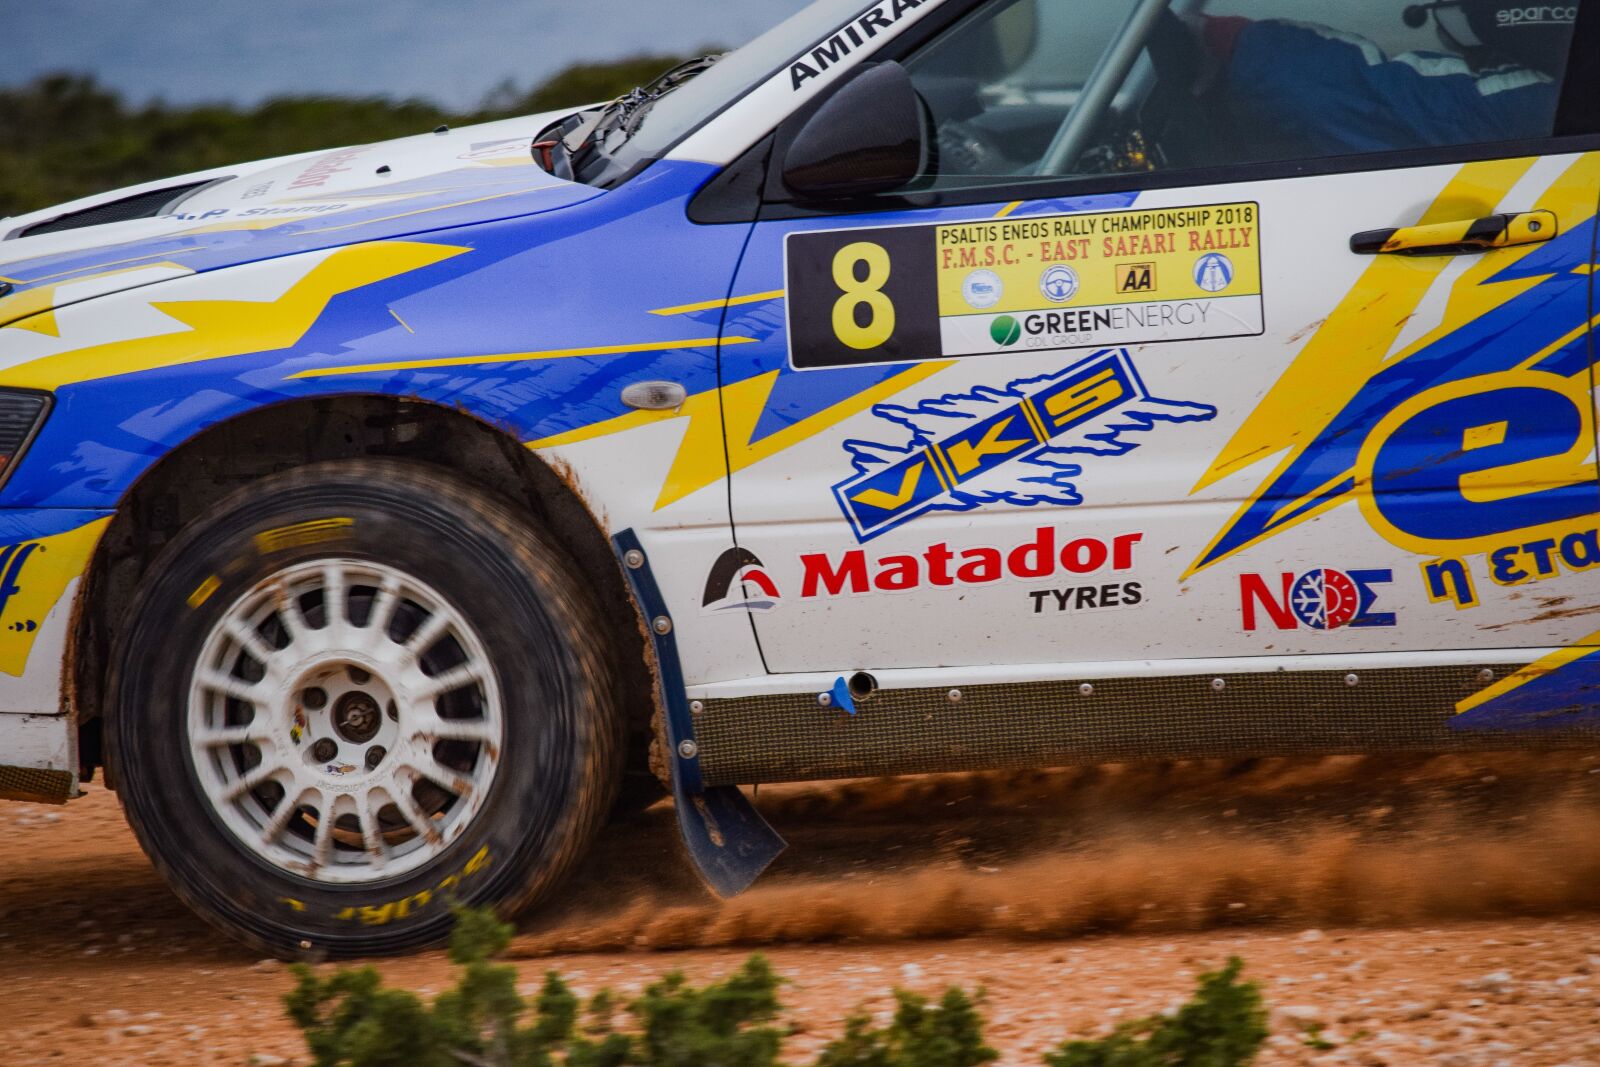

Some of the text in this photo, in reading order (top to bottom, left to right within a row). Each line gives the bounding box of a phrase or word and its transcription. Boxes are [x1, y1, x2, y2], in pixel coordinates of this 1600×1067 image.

[790, 0, 922, 91] AMIRA
[941, 207, 1253, 245] PSALTIS ENEOS RALLY CHAMPIONSHIP 2018
[942, 244, 1020, 269] F.M.S.C.
[1040, 238, 1091, 262] EAST
[1103, 232, 1176, 257] SAFARI
[1188, 227, 1253, 252] RALLY
[831, 241, 897, 350] 8
[1122, 270, 1151, 291] AA
[800, 527, 1144, 599] Matador
[1029, 581, 1144, 614] TYRES
